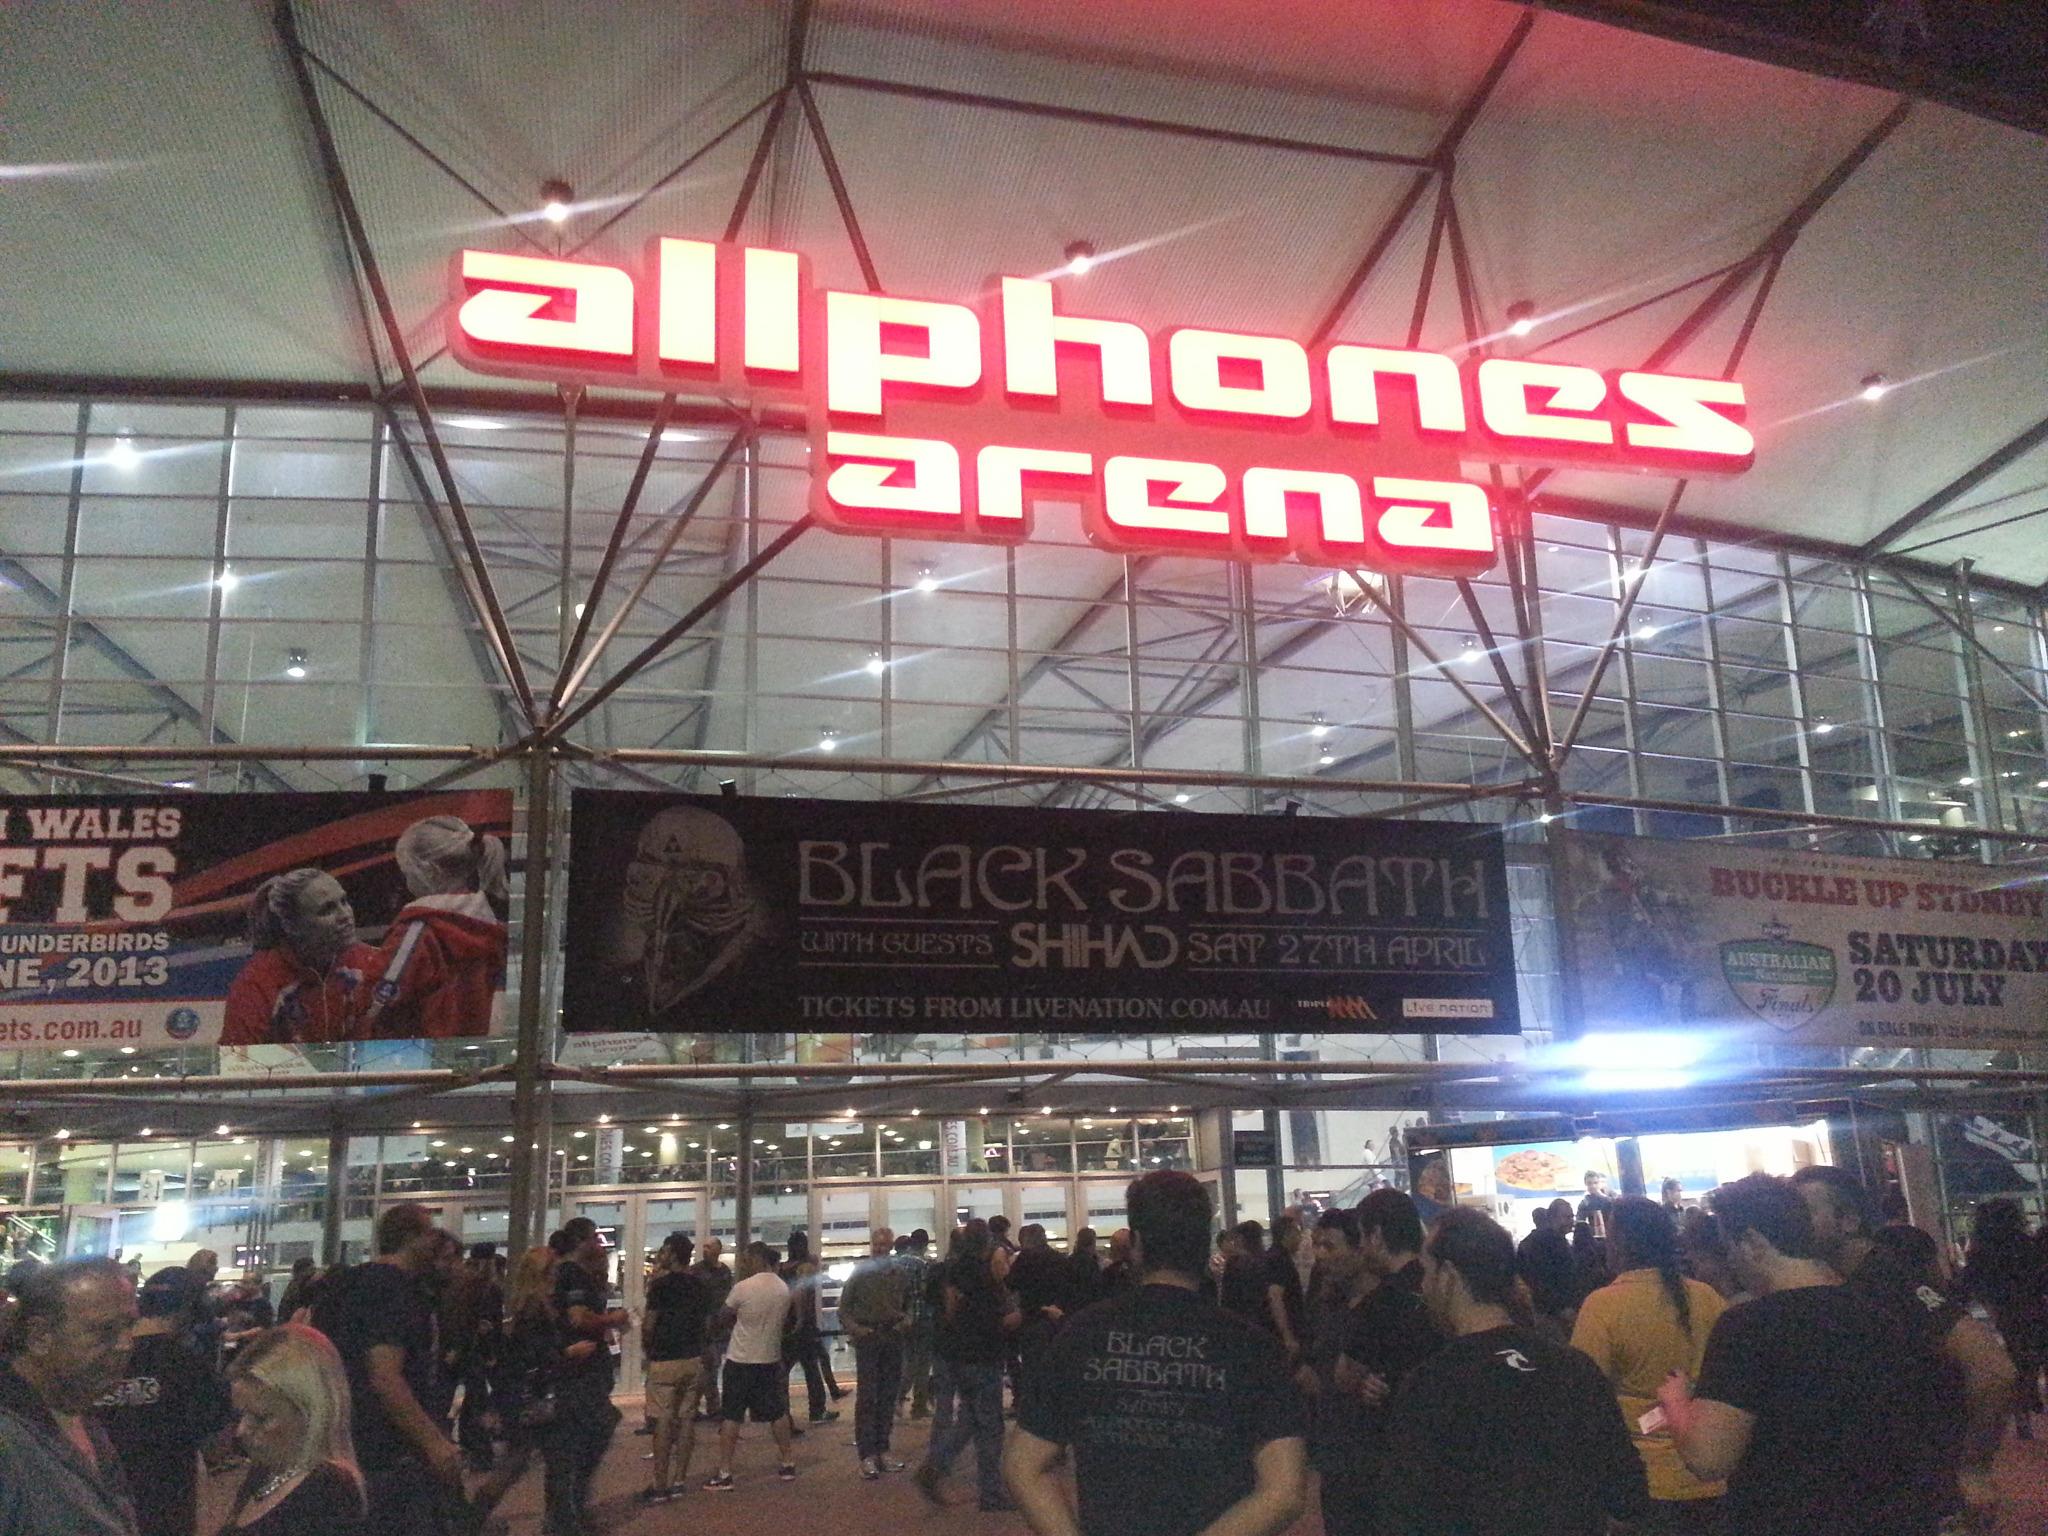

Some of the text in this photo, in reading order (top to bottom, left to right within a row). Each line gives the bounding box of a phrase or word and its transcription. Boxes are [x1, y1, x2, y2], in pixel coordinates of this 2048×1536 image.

[459, 237, 1754, 455] allphones
[827, 432, 1494, 552] arena
[27, 808, 182, 840] WALES
[799, 841, 1488, 919] BLACK SABBATH
[1709, 867, 1858, 906] BUCKLE
[1863, 879, 1910, 909] UP
[1916, 882, 2045, 918] SYDNEY
[801, 931, 993, 955] WITH GUESTS
[1011, 922, 1179, 969] SHIHAD
[1188, 932, 1487, 968] SAT 27TH APRIL
[66, 955, 169, 988] 2013
[1727, 951, 1832, 971] AUSTRALIAN
[1853, 968, 2005, 1007] 20 JULY
[801, 996, 915, 1018] TICKETS
[924, 997, 1002, 1018] FROM
[1107, 1331, 1209, 1359] BLACK
[1083, 1358, 1227, 1390] SABBATH
